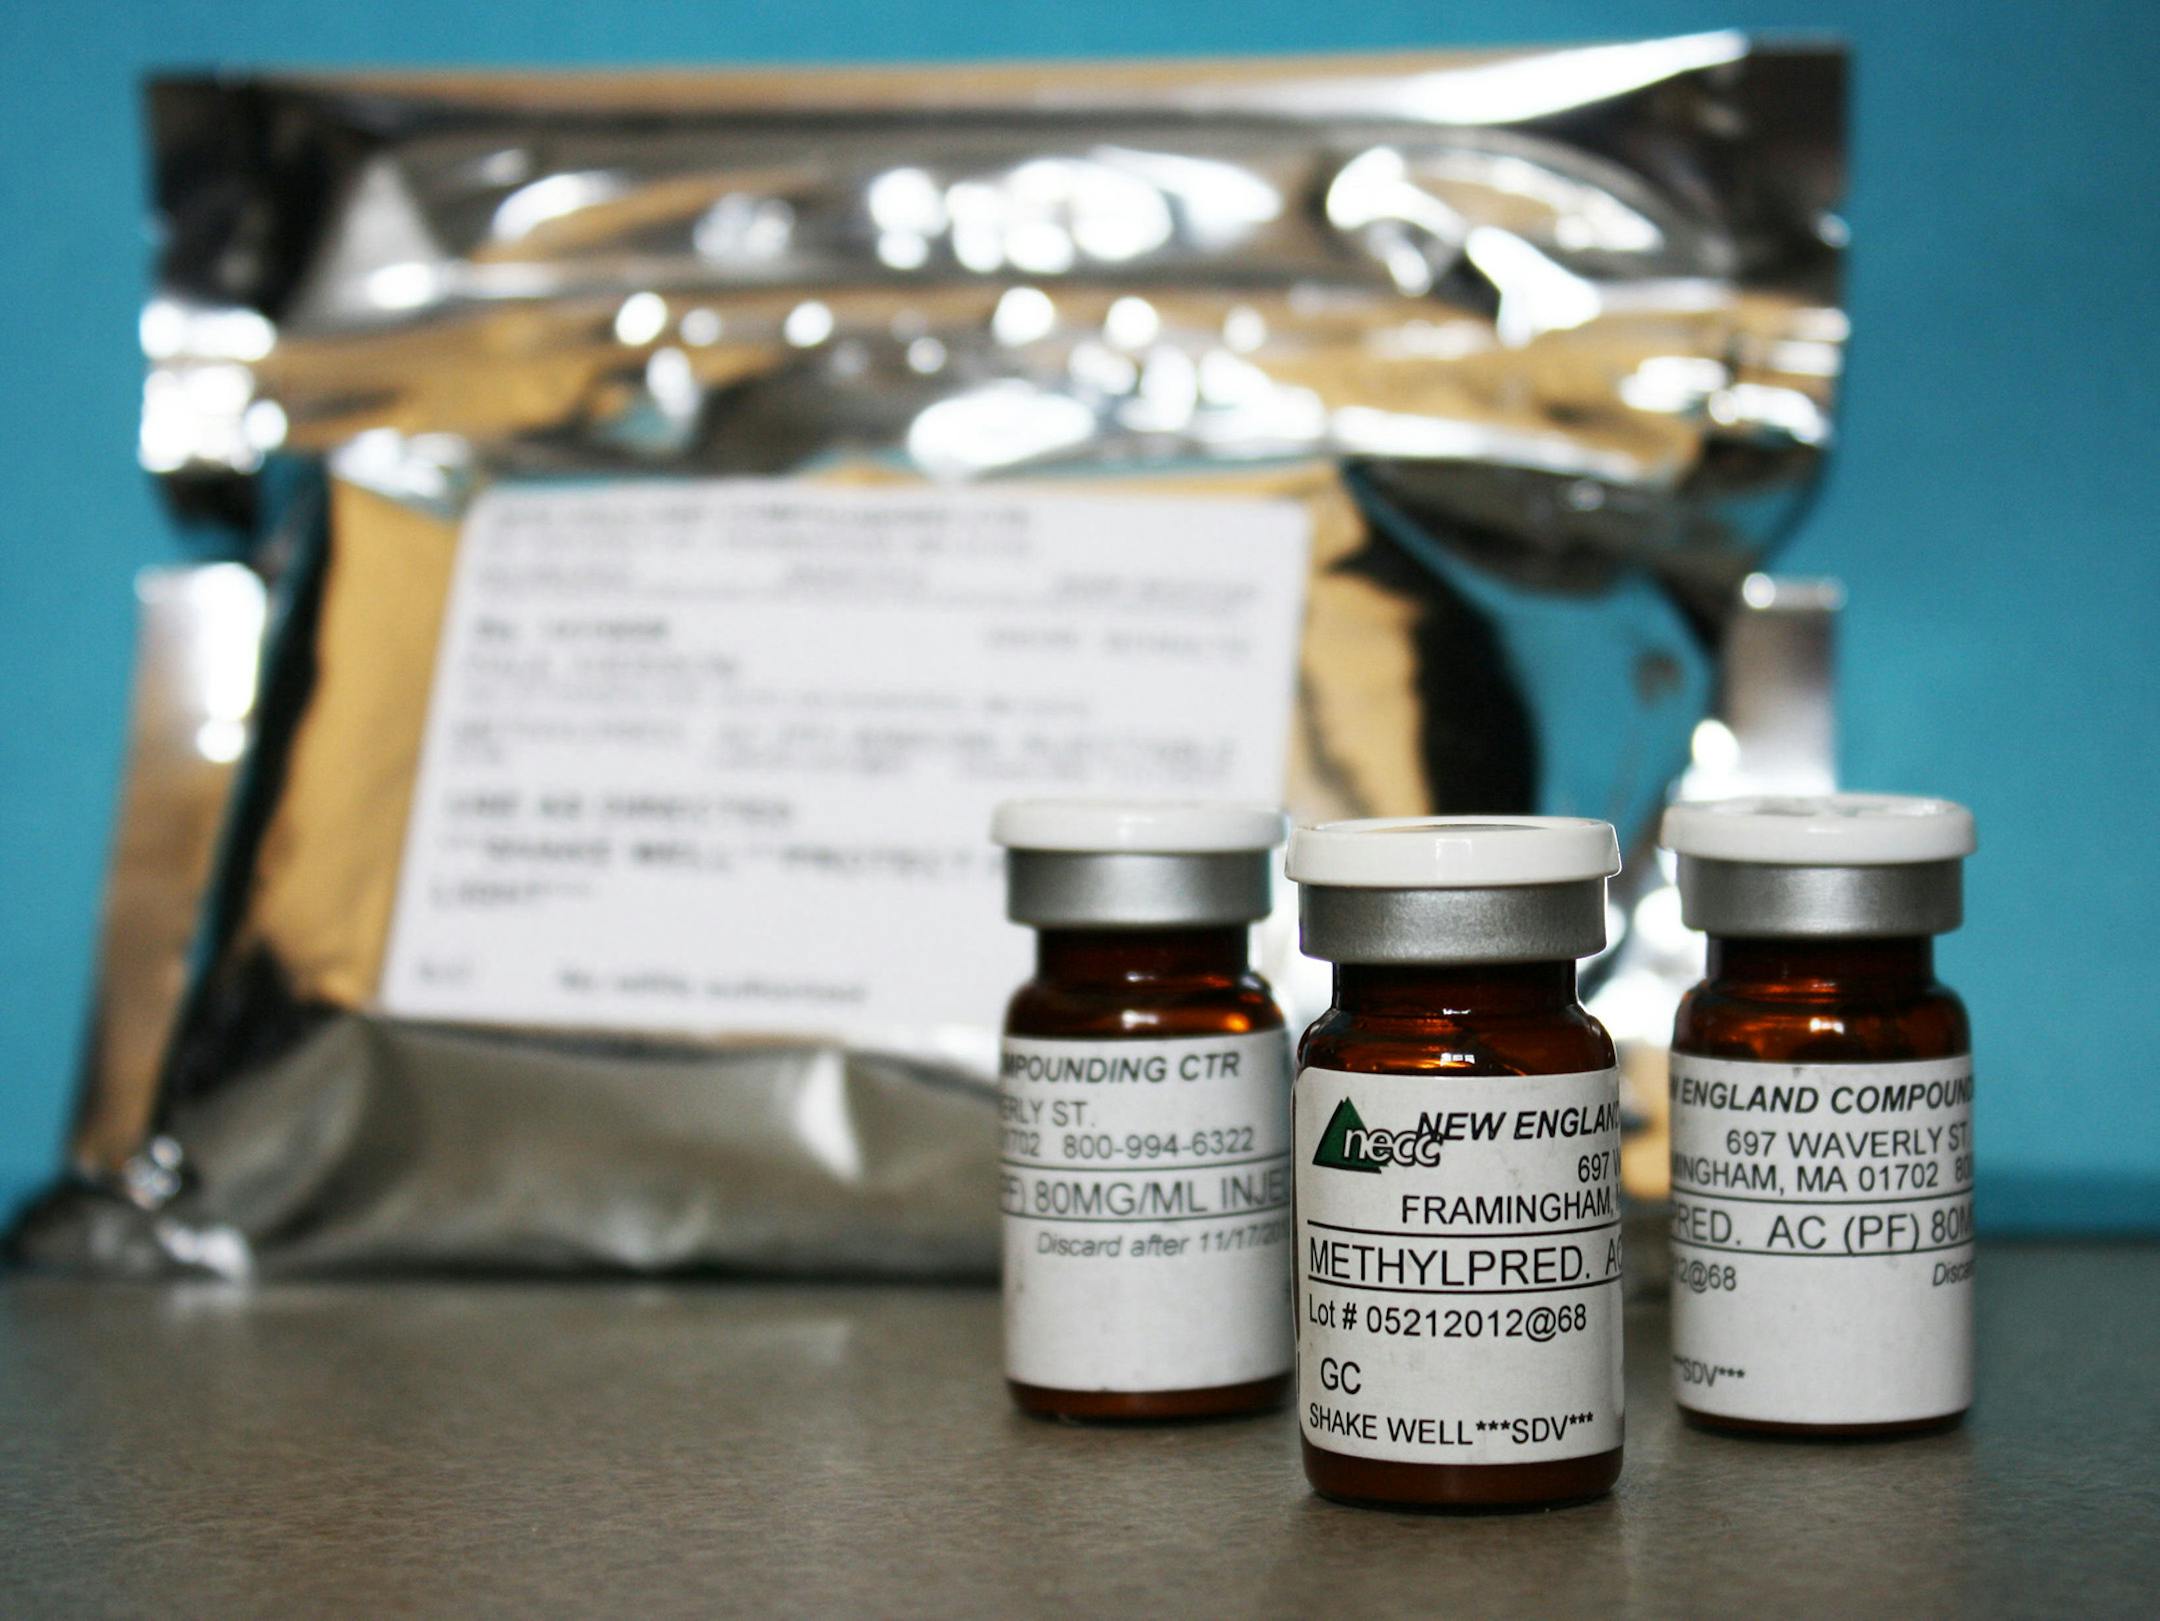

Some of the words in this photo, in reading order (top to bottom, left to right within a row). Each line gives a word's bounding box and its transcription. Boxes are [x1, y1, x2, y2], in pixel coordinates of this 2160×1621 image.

[1179, 1051, 1241, 1082] CTR
[1052, 1099, 1096, 1128] ST.
[1682, 1078, 1819, 1114] ENGLAND
[1063, 1127, 1255, 1160] 800-994-6322
[1415, 1111, 1507, 1142] NEW
[1726, 1129, 1776, 1157] 697
[1788, 1126, 1944, 1159] WAVERLY
[1342, 1126, 1443, 1168] necc
[1577, 1151, 1610, 1184] 697
[1797, 1166, 1848, 1192] MA
[1858, 1161, 1939, 1192] 01702
[1034, 1179, 1208, 1216] 80MG/ML
[1401, 1187, 1614, 1225] FRAMINGHAM,
[1037, 1232, 1123, 1258] Discard
[1130, 1233, 1190, 1258] after
[1767, 1215, 1827, 1250] AC
[1844, 1213, 1920, 1257] (PF)
[1309, 1236, 1591, 1286] METHYLPRED.
[1309, 1293, 1336, 1329] Lot
[1342, 1302, 1358, 1331] #
[1366, 1303, 1587, 1342] 05212012@68
[1320, 1357, 1362, 1395] GC
[1309, 1402, 1378, 1440] SHAKE
